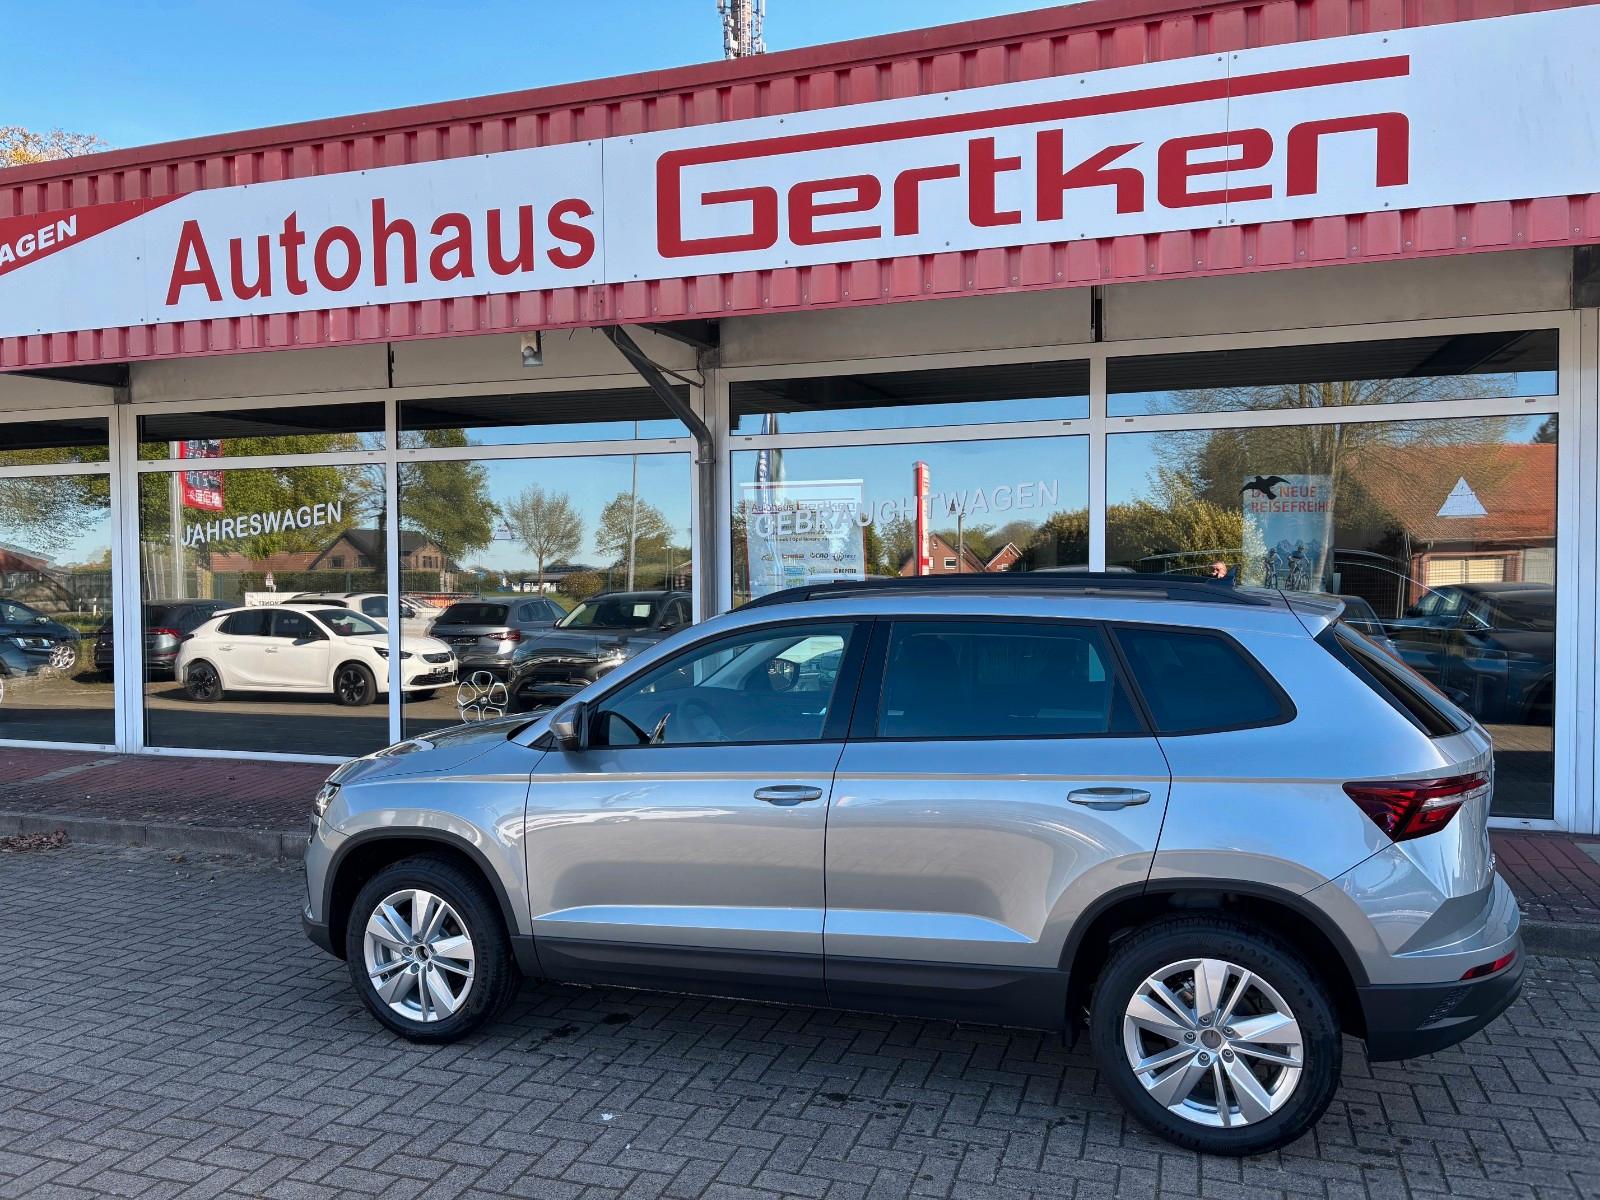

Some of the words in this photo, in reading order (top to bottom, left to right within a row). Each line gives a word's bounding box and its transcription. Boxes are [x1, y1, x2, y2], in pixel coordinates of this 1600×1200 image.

[166, 197, 596, 305] Autohaus
[656, 54, 1410, 258] Gertken
[755, 479, 1060, 538] GEBRAUCHTWAGEN
[1279, 486, 1317, 498] NEUE
[181, 501, 342, 546] JAHRESWAGEN
